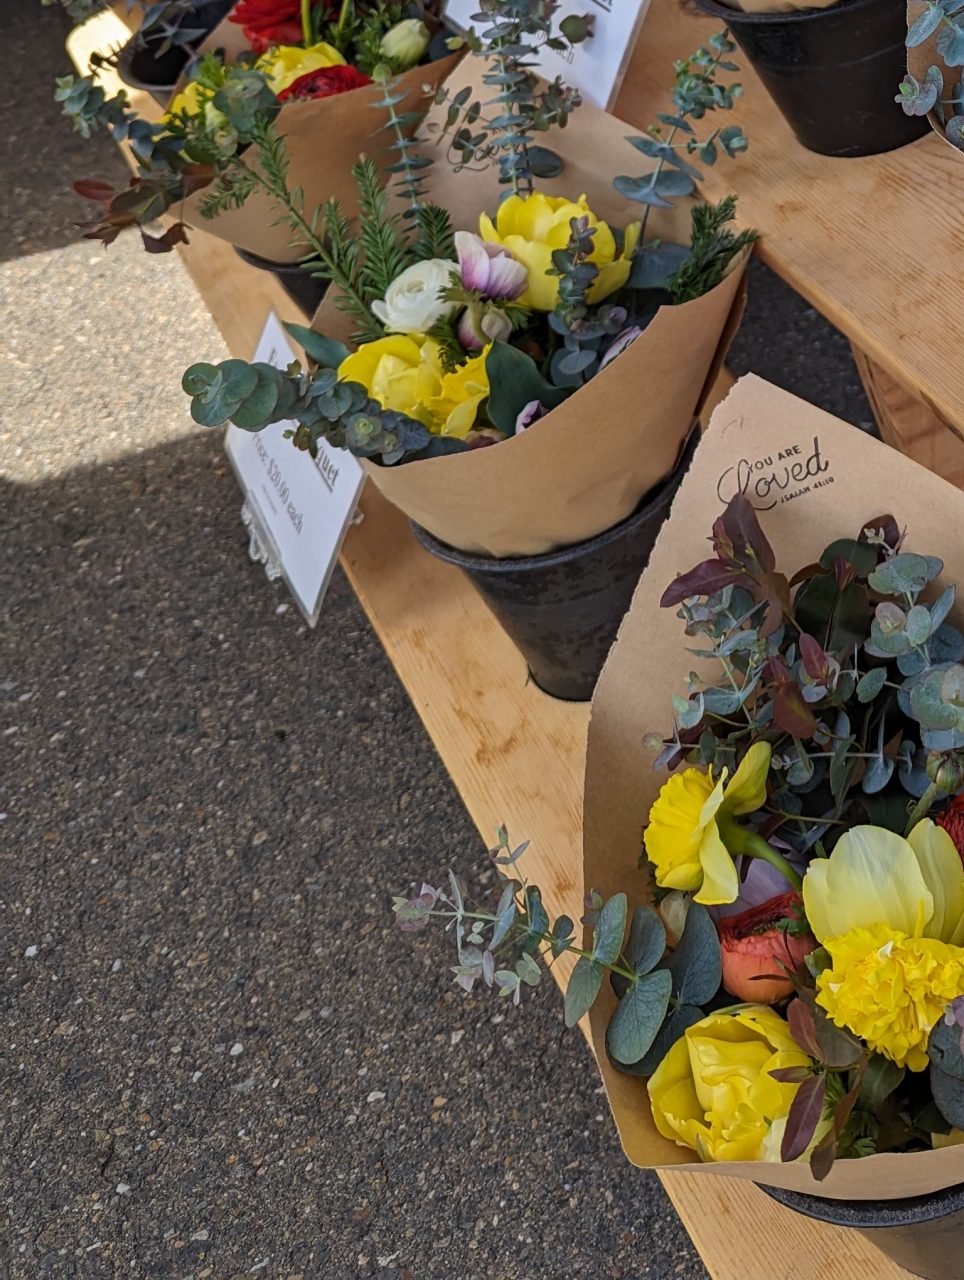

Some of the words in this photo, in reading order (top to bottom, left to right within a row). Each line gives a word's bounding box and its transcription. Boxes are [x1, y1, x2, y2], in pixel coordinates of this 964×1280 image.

[748, 456, 773, 473] YOU
[777, 444, 802, 461] ARE
[717, 436, 830, 511] Loved
[780, 486, 811, 504] ISAIAH
[812, 476, 835, 491] 41:10
